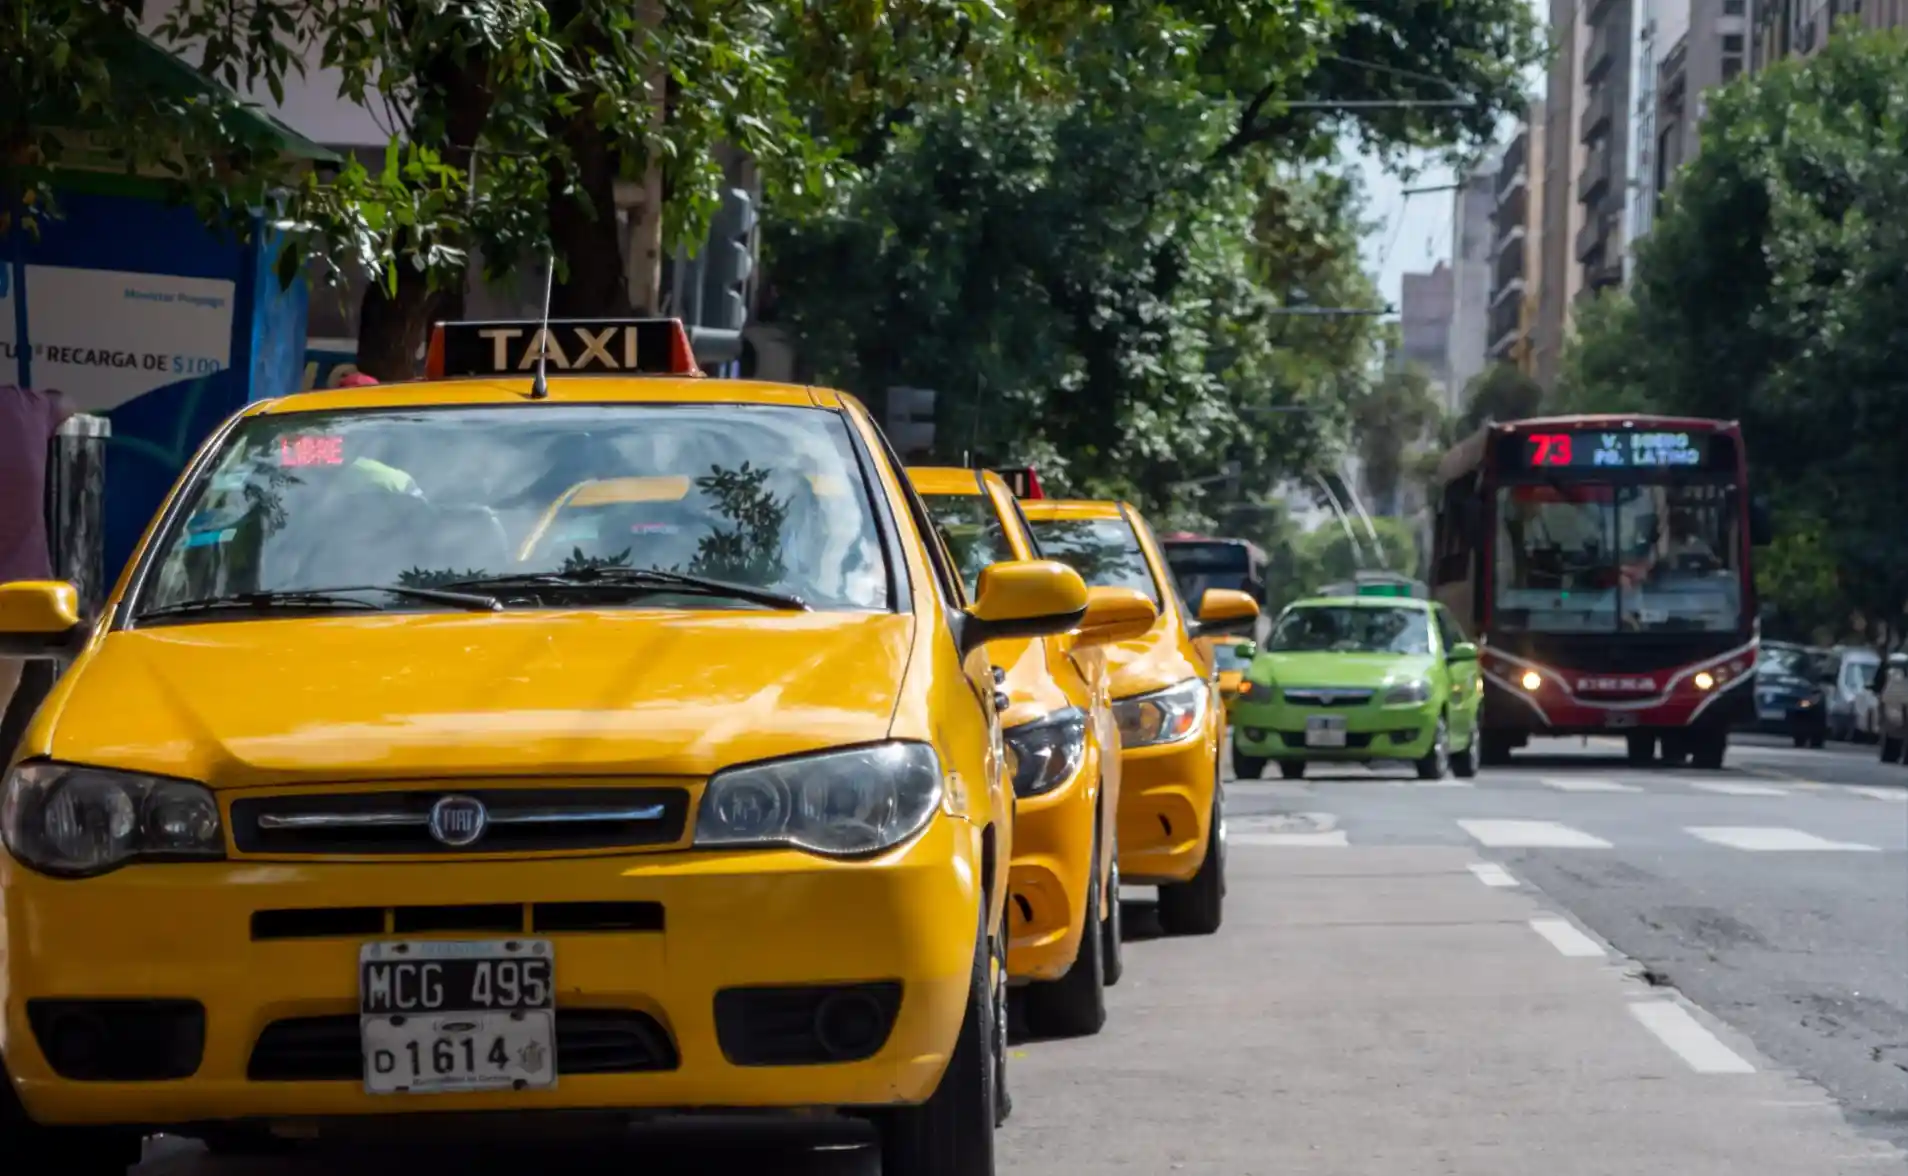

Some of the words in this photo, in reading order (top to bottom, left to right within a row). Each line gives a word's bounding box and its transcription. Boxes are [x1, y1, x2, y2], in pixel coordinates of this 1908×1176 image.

[47, 345, 137, 369] RECARGA
[143, 354, 167, 372] DE
[478, 326, 638, 371] TAXI
[280, 436, 344, 467] LIBRE
[1528, 433, 1573, 466] 73
[368, 963, 444, 1009] MCG
[471, 961, 546, 1007] 495
[405, 1036, 511, 1077] 1614
